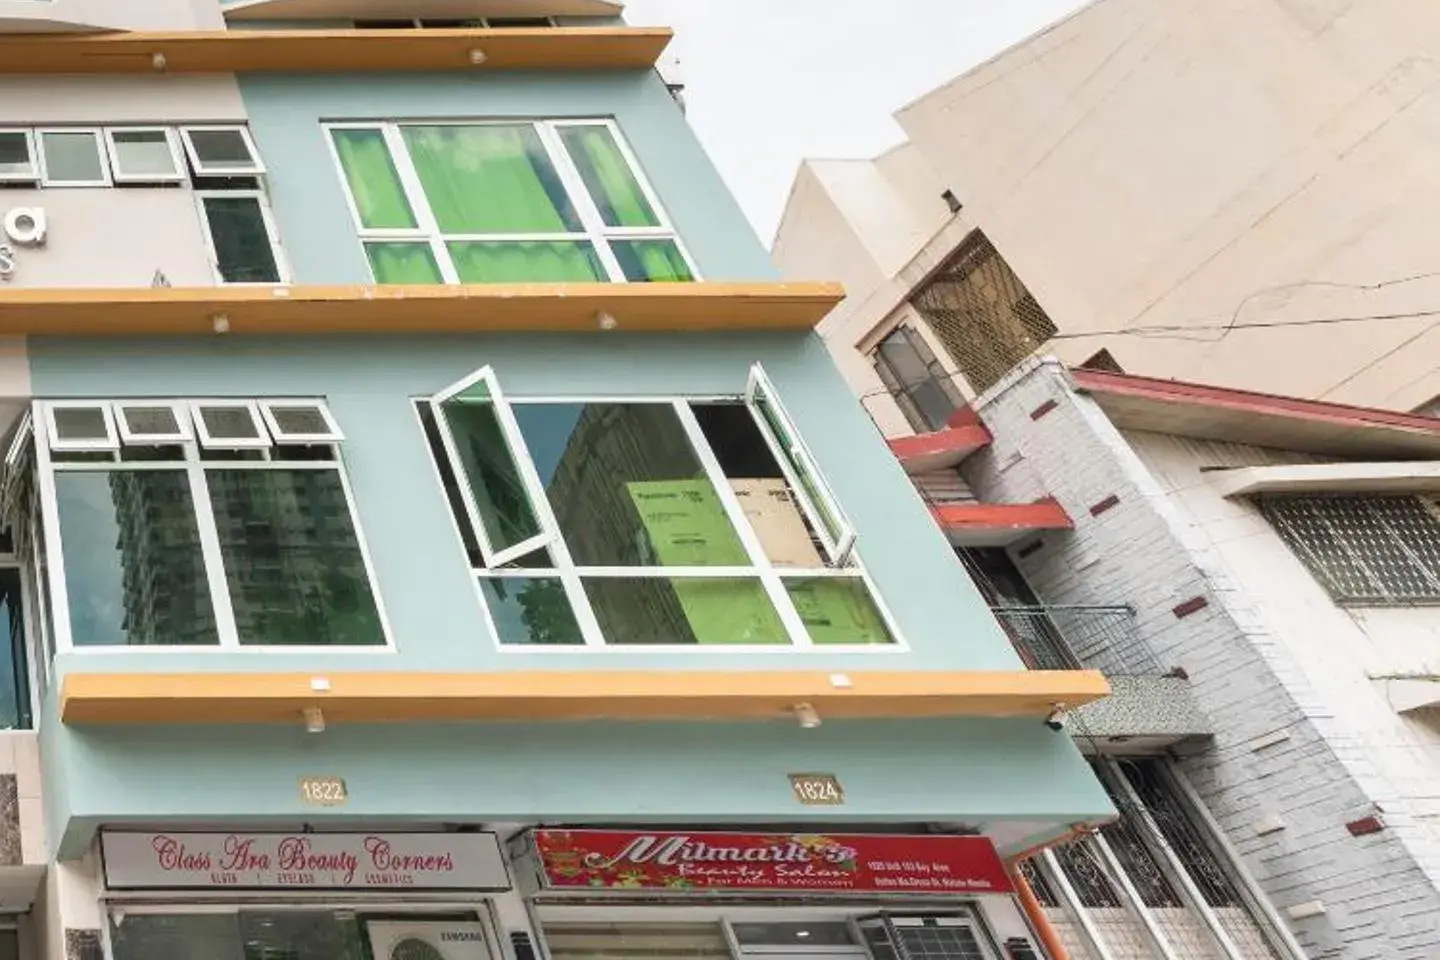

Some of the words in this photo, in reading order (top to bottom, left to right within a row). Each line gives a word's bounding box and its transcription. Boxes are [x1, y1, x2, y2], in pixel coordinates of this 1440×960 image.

[302, 781, 344, 800] 1822
[794, 780, 838, 800] 1824
[152, 835, 211, 871] Class
[278, 837, 358, 883] Beauty
[364, 836, 454, 871] Corners
[677, 863, 764, 879] Beauty
[776, 862, 849, 877] Salon
